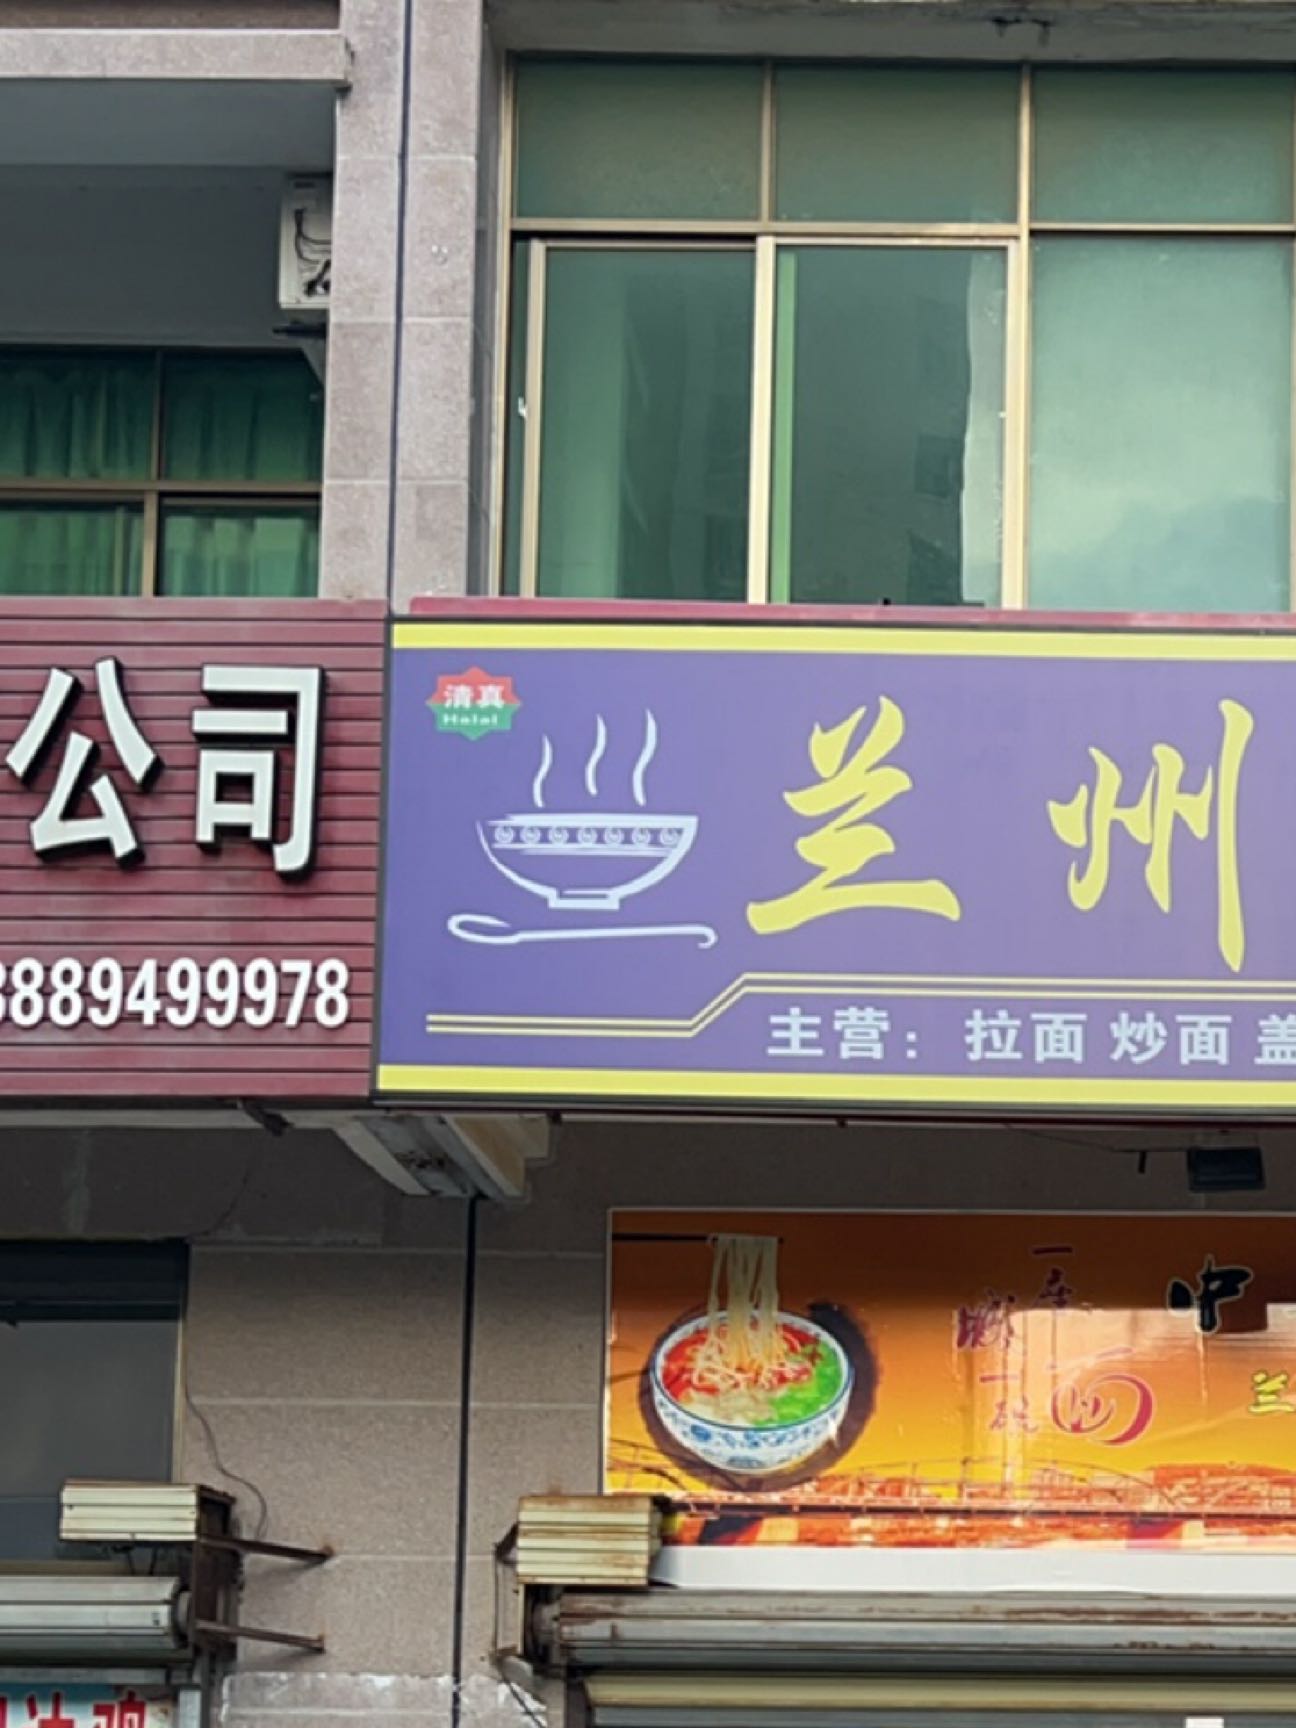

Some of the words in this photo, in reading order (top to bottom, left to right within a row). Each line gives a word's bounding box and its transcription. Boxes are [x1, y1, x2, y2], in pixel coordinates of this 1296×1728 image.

[443, 684, 504, 710] 清真
[6, 655, 325, 877] 公司
[746, 696, 1254, 973] 兰州
[0, 957, 349, 1027] 889499978
[965, 1009, 1087, 1064] 拉面
[1110, 1011, 1231, 1065] 炒面
